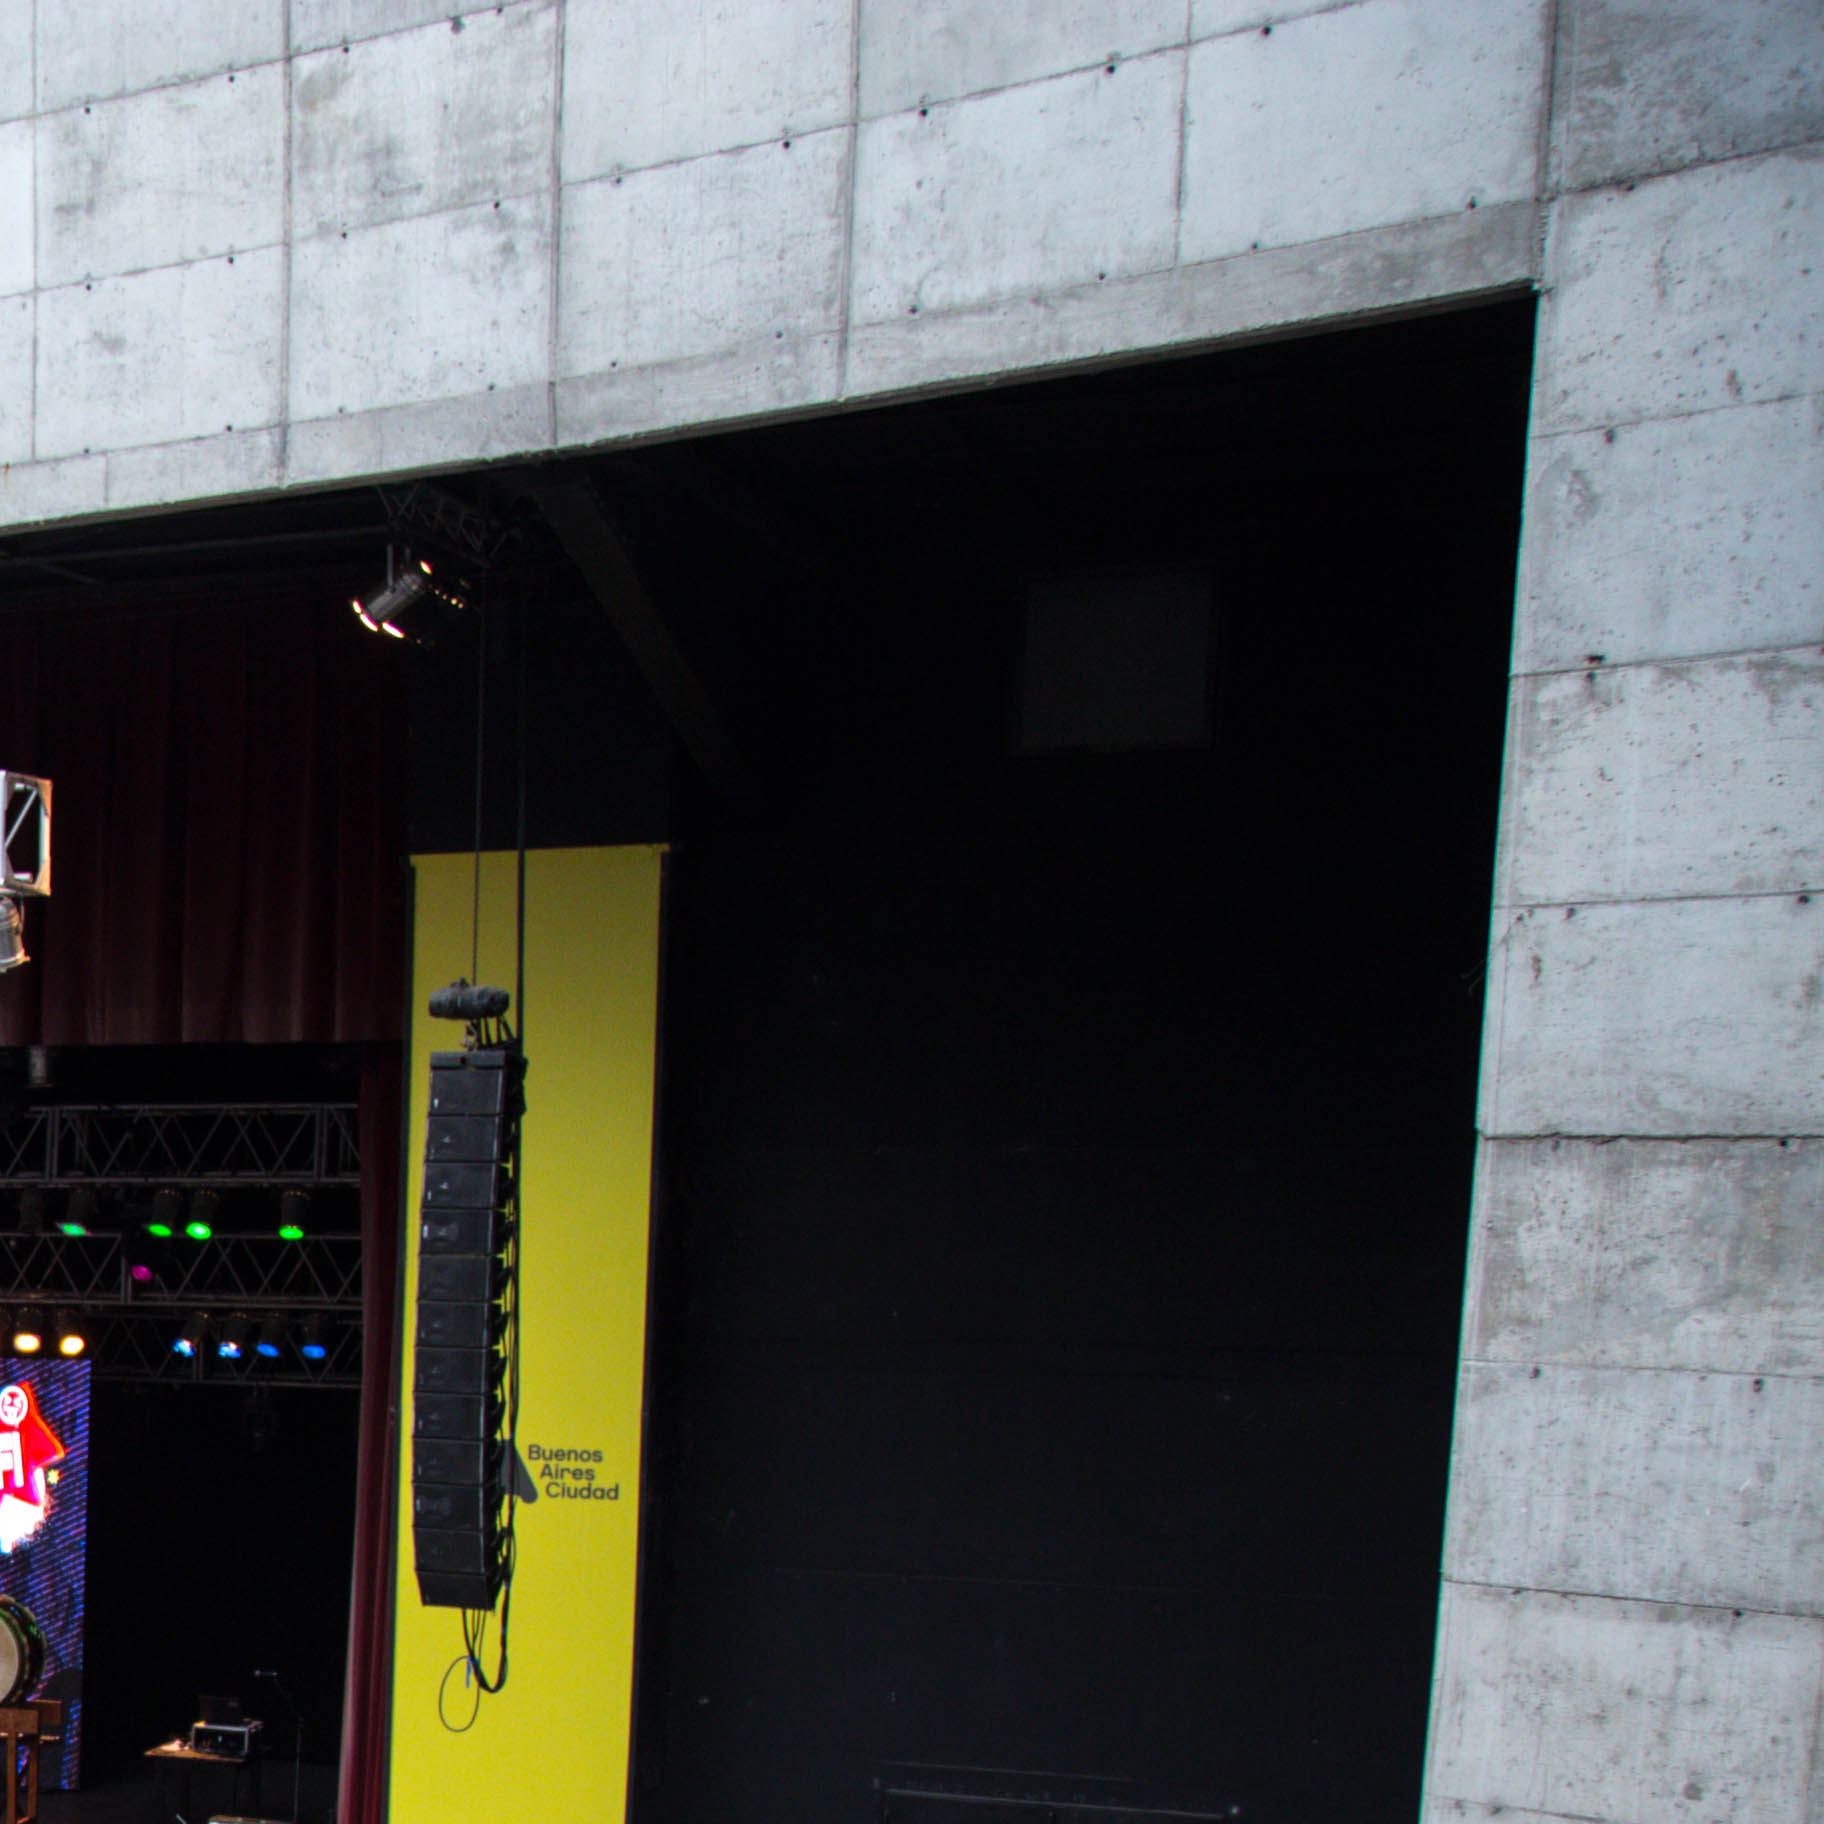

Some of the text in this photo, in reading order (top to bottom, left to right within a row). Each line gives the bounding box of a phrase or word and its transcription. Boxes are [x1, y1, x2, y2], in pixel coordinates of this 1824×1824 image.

[528, 1444, 604, 1463] Buenos
[540, 1464, 595, 1481] Aires
[545, 1482, 620, 1501] Ciudad
